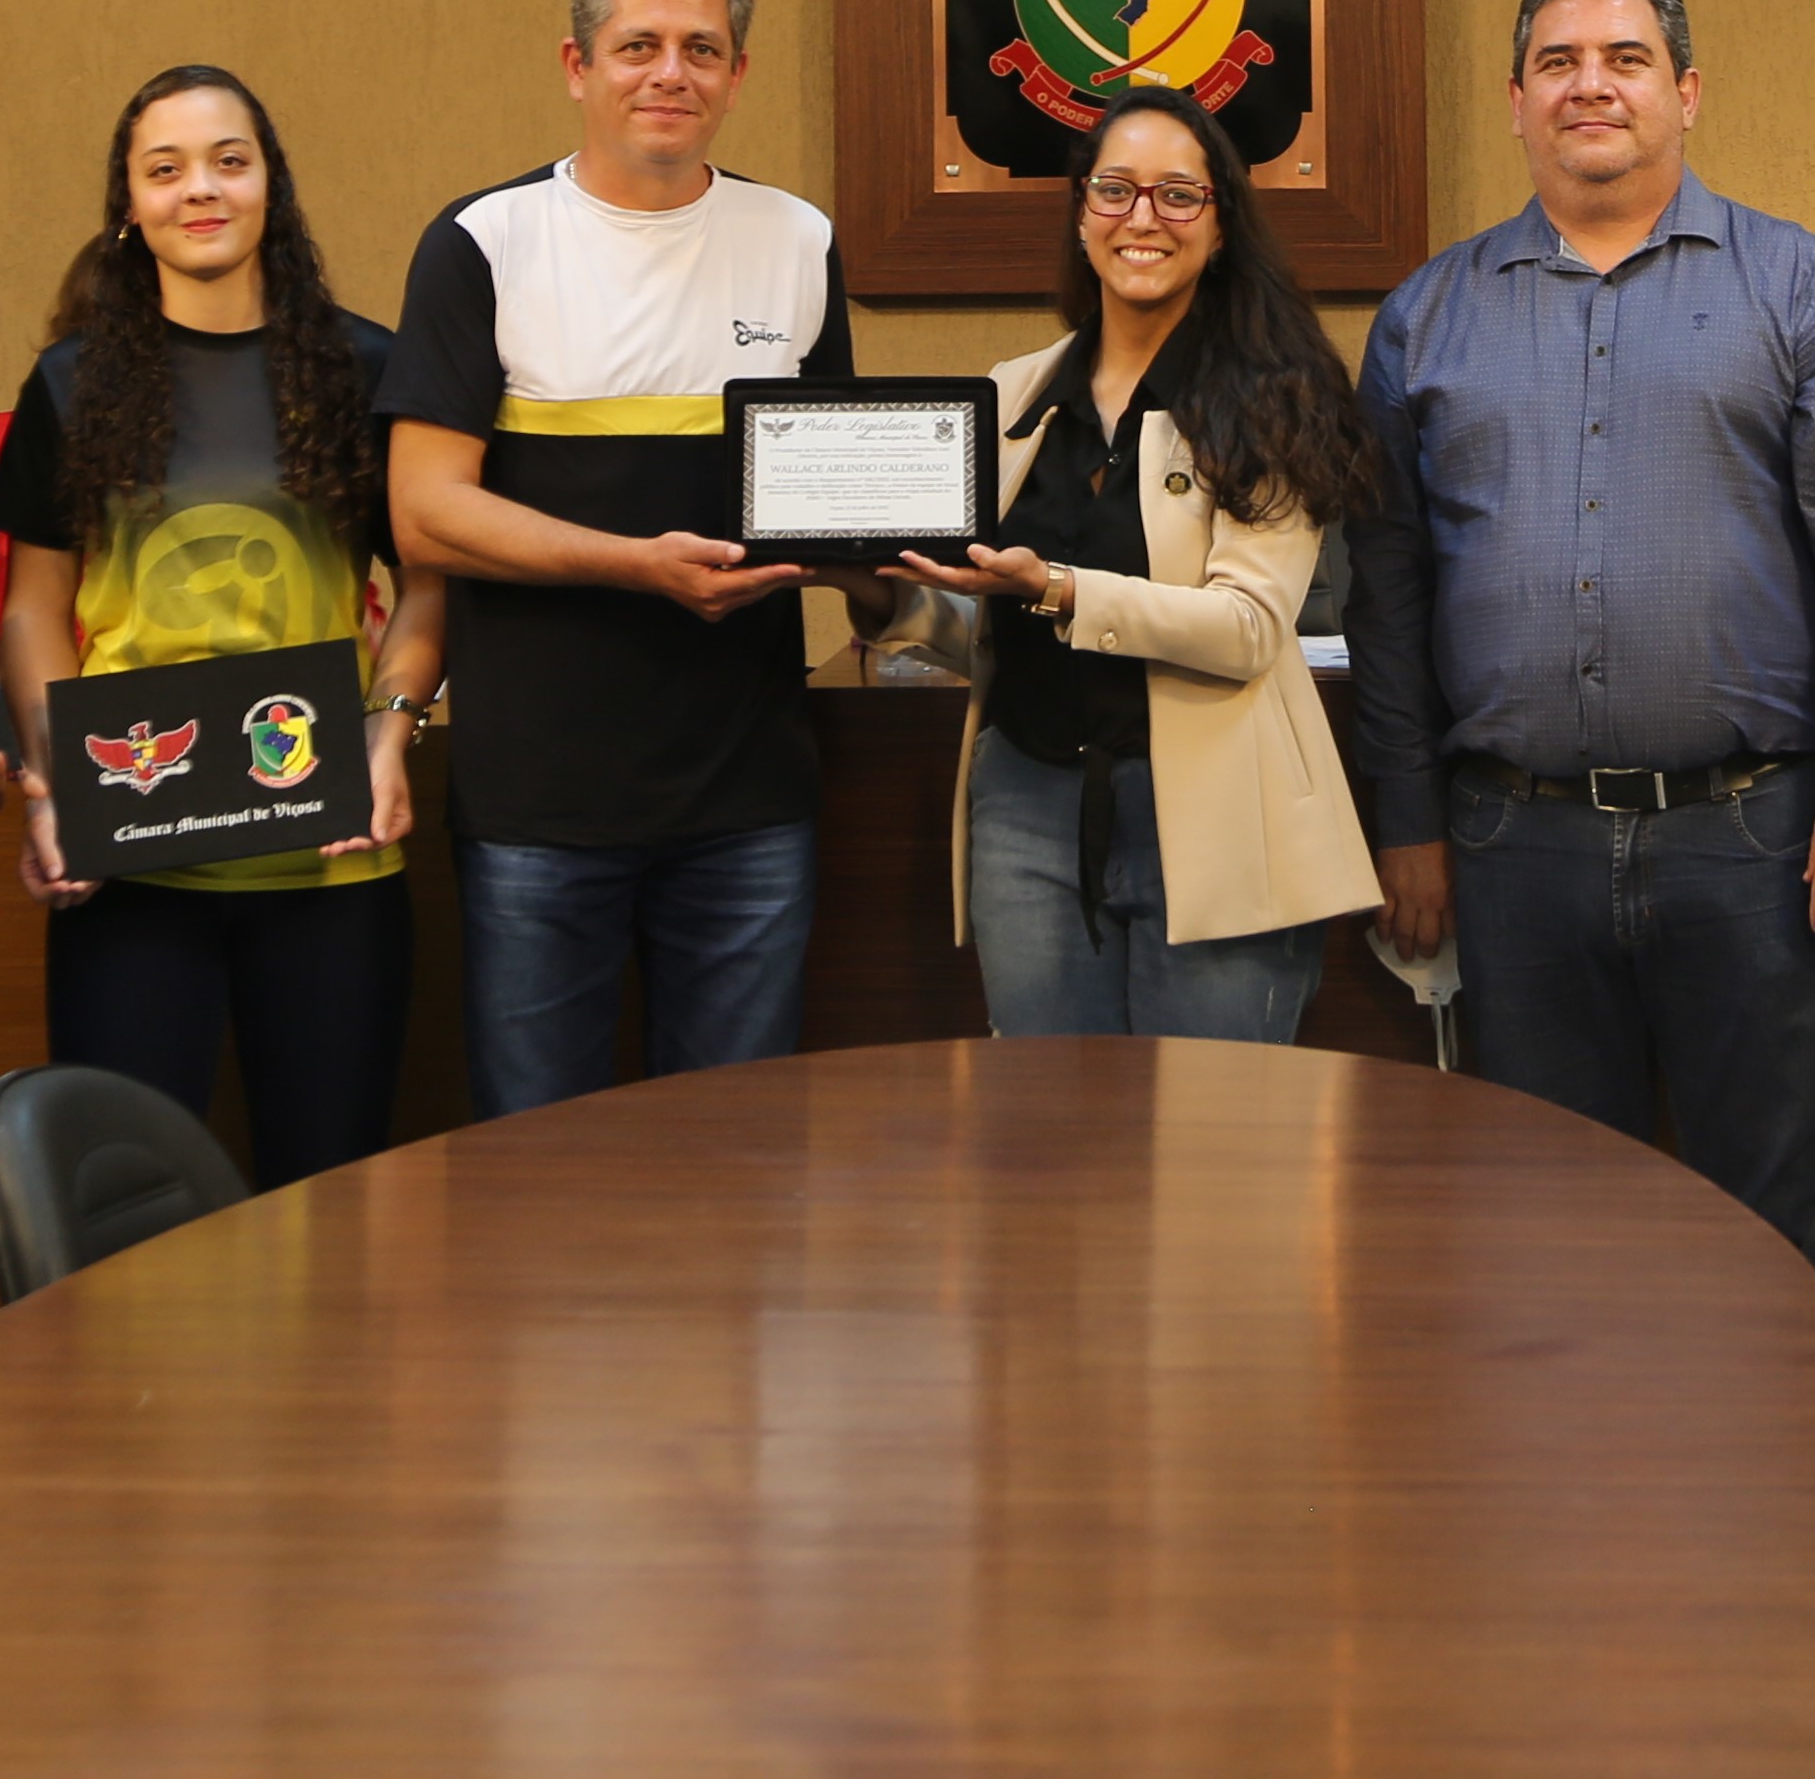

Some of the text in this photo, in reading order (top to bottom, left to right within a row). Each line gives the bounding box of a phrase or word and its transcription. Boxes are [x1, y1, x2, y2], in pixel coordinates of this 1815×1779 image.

[1036, 80, 1235, 127] O PODER ORTE
[797, 416, 841, 432] Poder
[770, 462, 950, 474] WALLACE ARLINDO CALDERANO
[113, 799, 325, 842] Câmara Municipal de Viçosa
